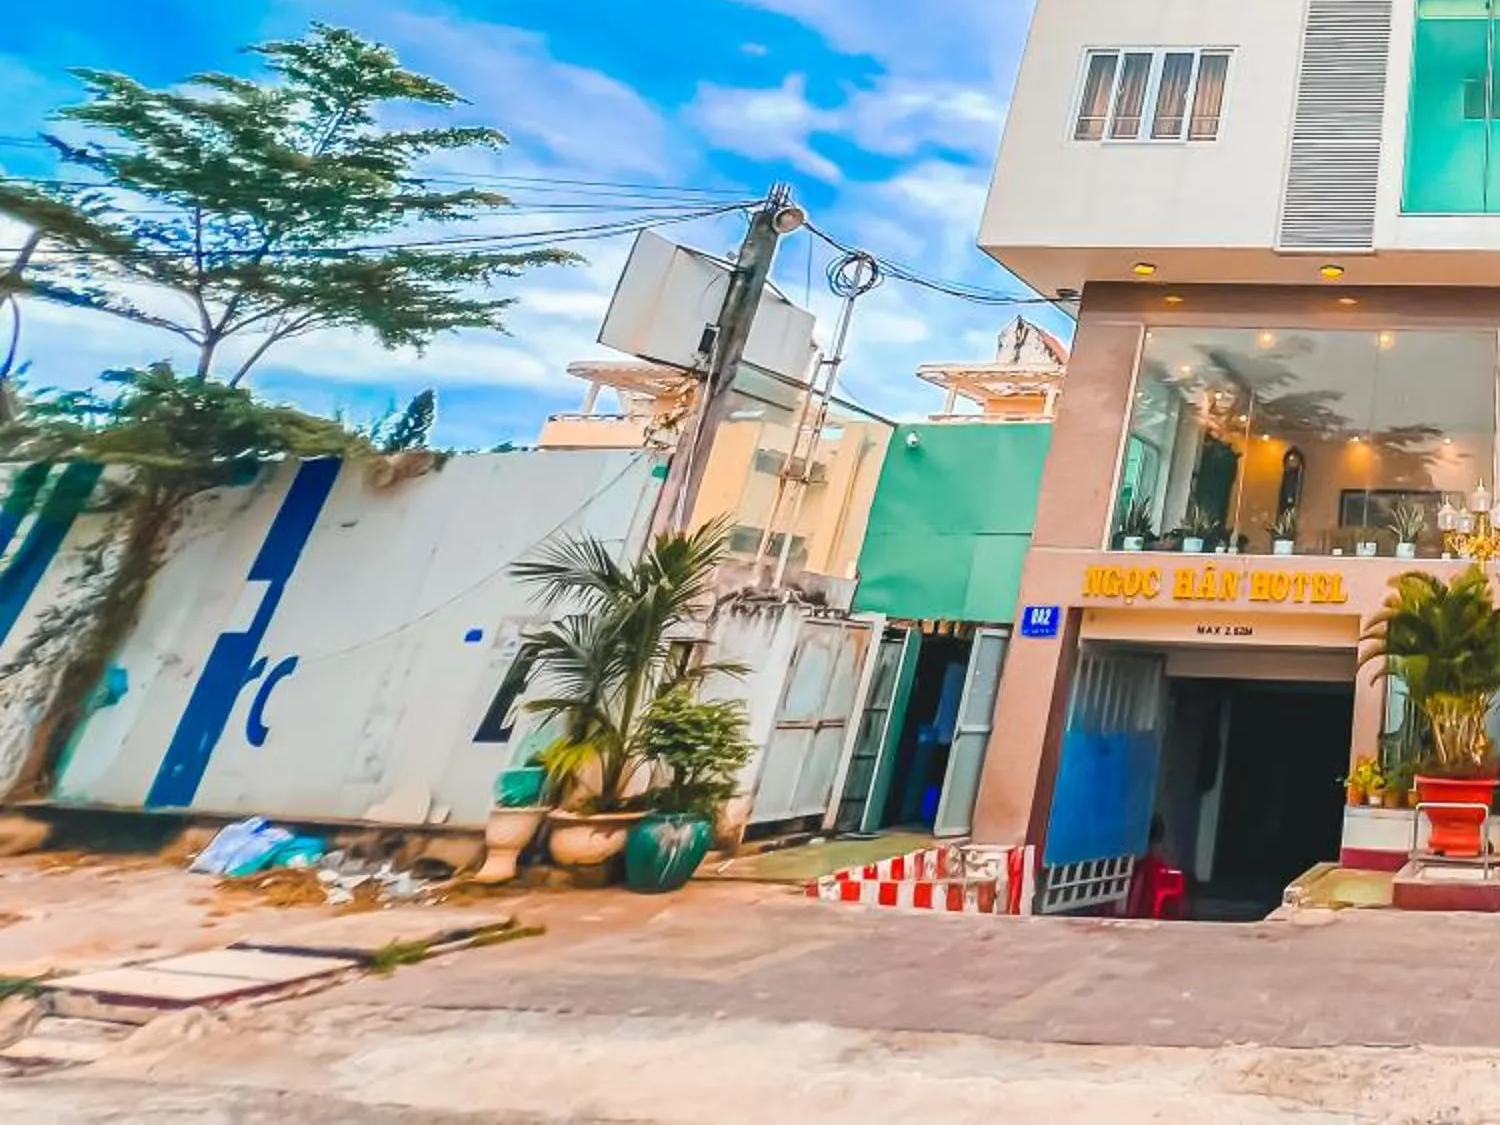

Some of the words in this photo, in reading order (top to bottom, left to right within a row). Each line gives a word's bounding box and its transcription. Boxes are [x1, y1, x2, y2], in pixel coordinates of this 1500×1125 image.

[1082, 565, 1162, 605] NGỌC
[1173, 561, 1239, 602] HÂN
[1248, 570, 1348, 604] HOTEL
